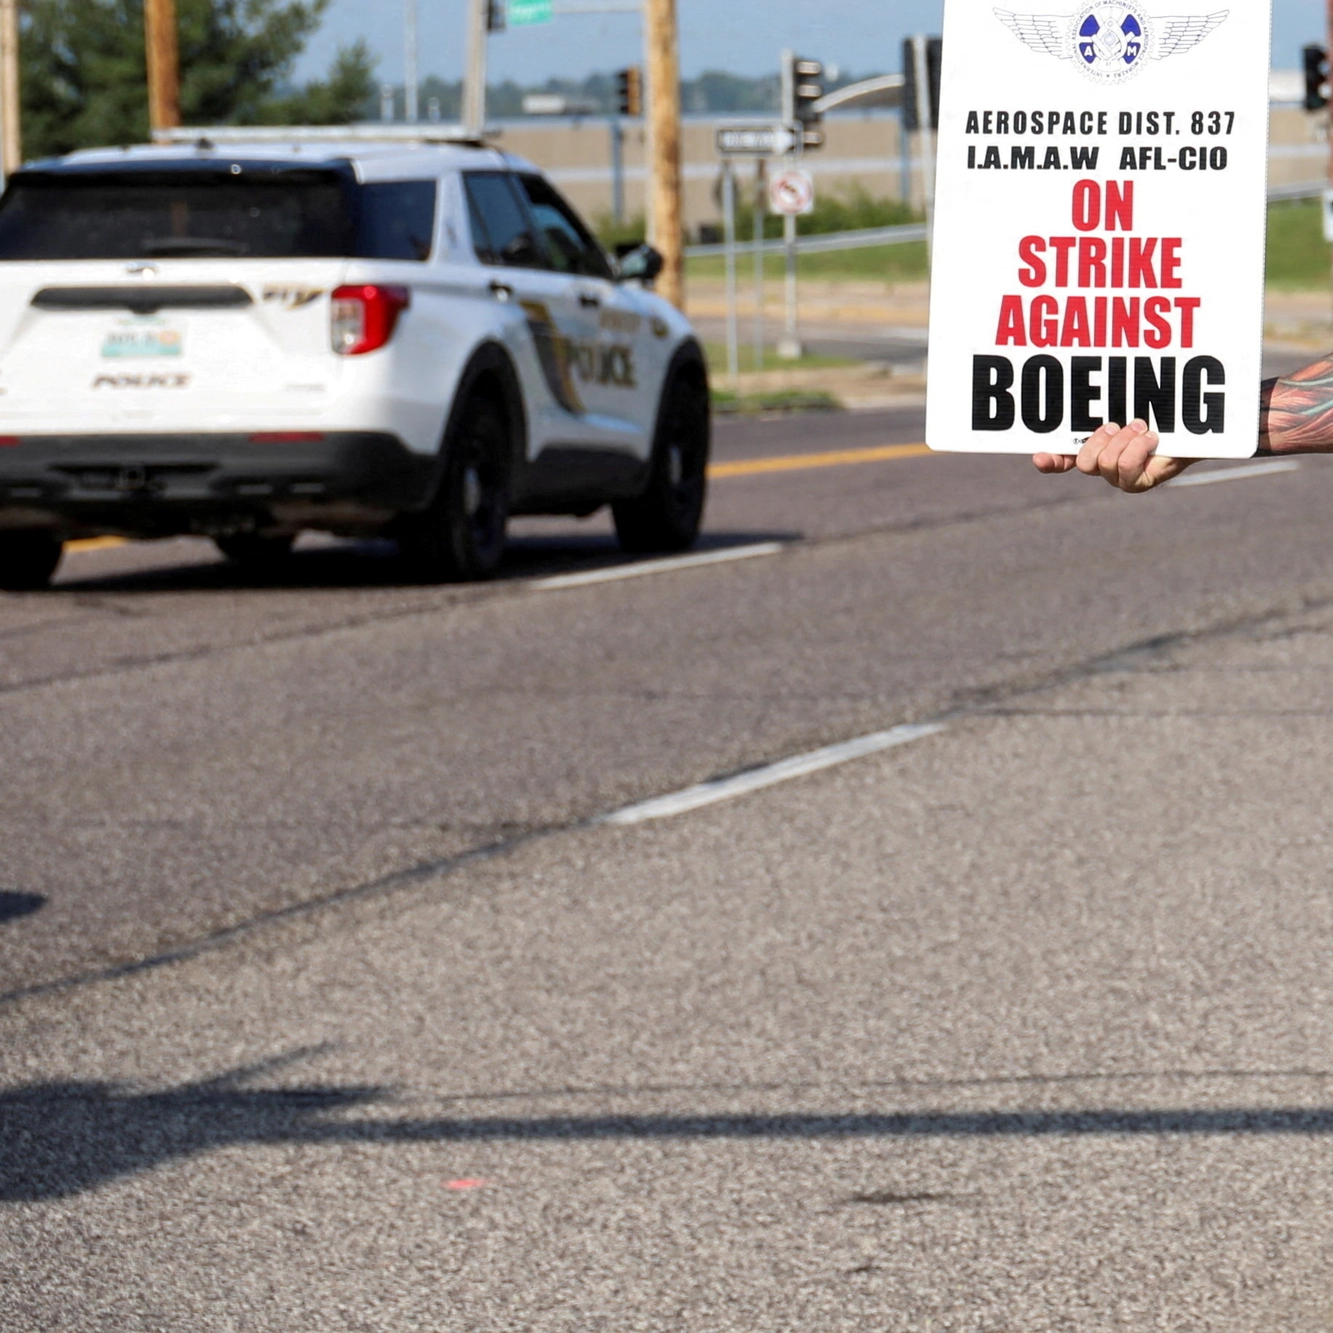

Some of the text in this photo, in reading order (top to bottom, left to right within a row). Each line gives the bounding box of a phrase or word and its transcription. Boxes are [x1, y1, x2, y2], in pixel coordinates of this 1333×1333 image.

[965, 110, 1235, 135] AEROSPACE DIST. 837
[967, 146, 1228, 171] I.A.M.A.W AFL-CIO
[1071, 179, 1134, 232] ON
[1018, 235, 1182, 289] STRIKE
[995, 294, 1201, 349] AGAINST
[92, 371, 191, 389] POLICE
[971, 353, 1226, 435] BOEING
